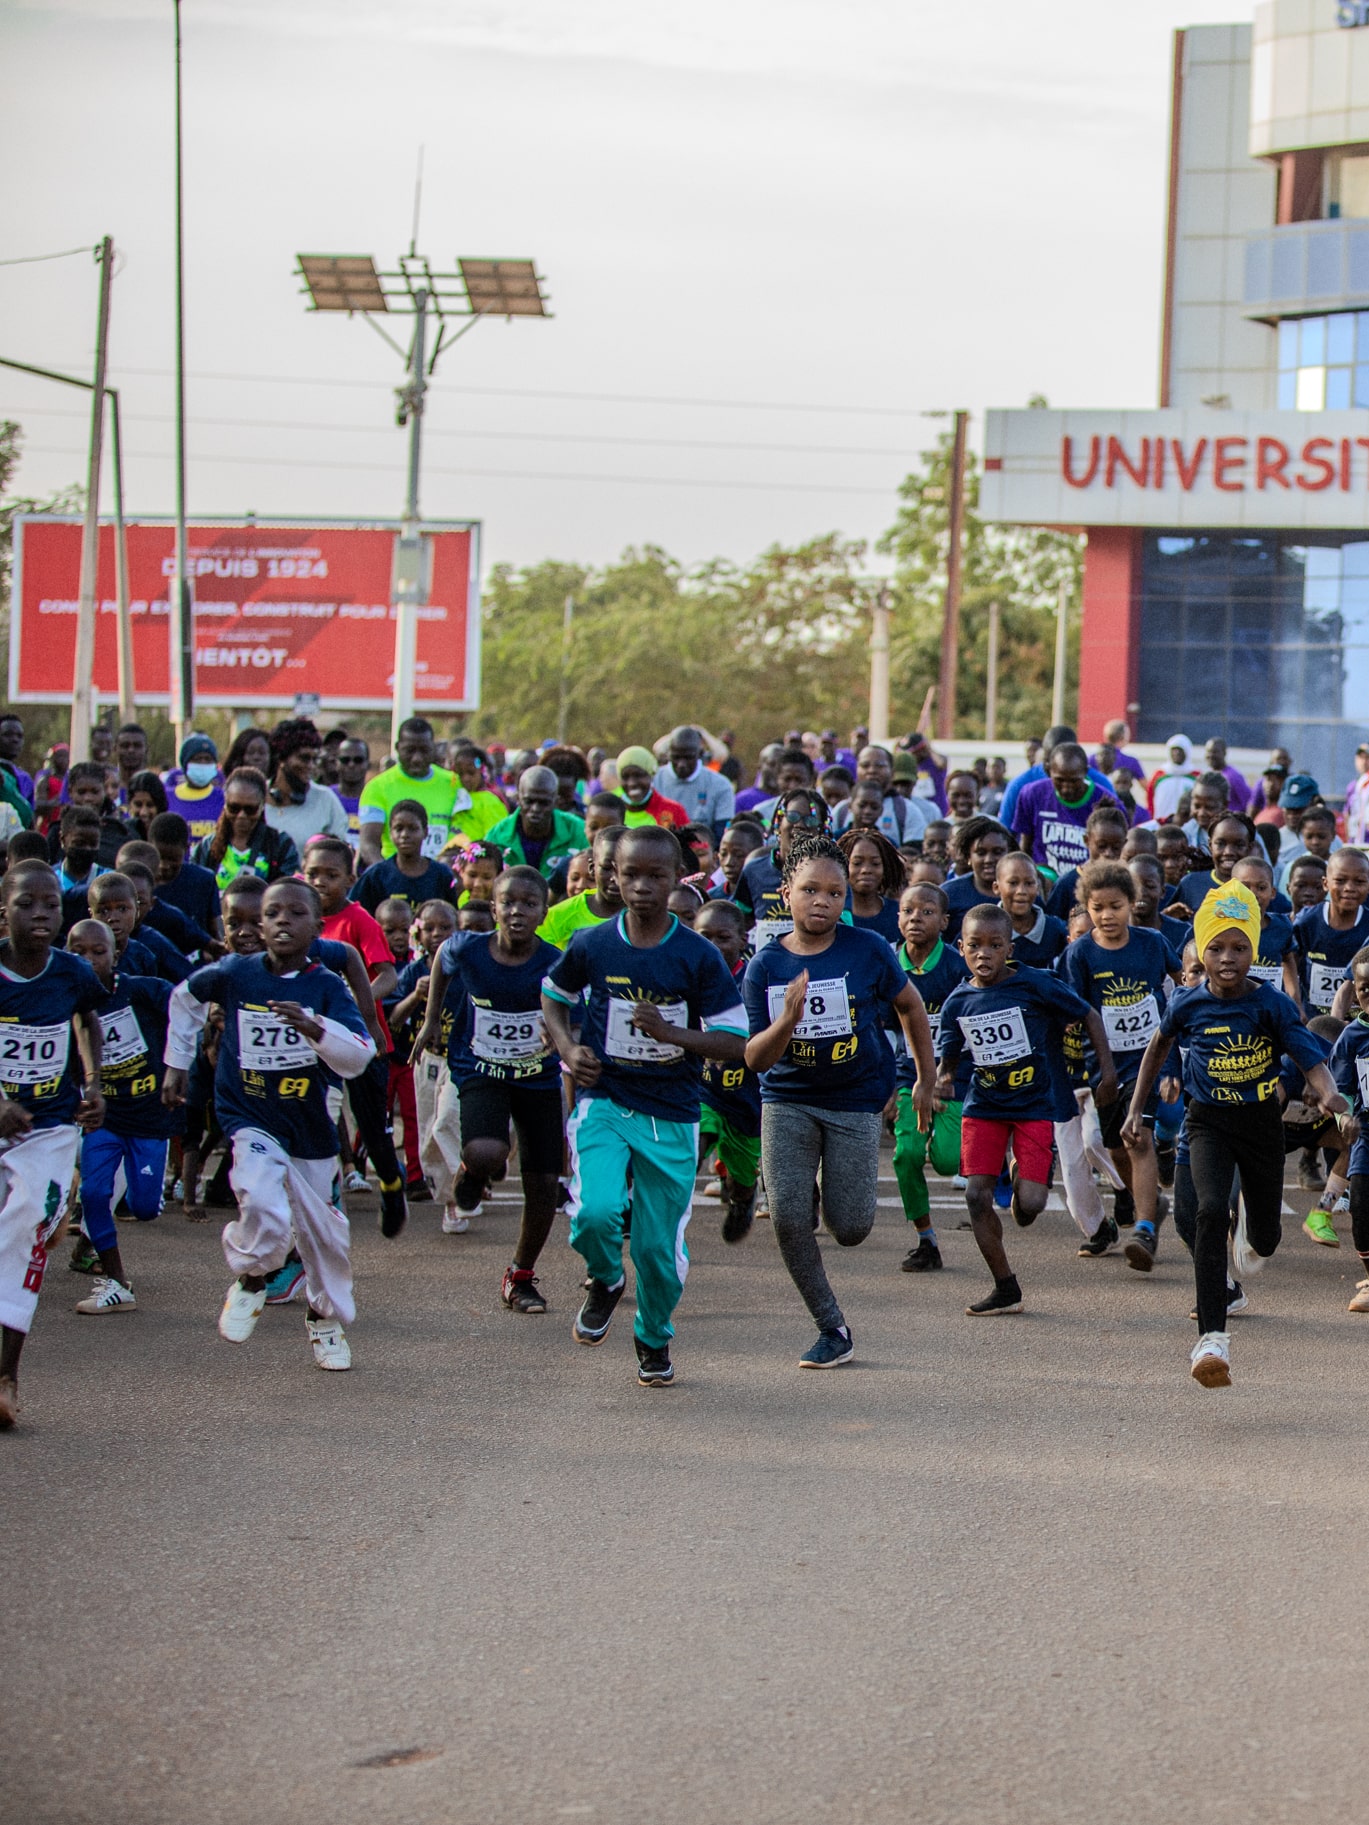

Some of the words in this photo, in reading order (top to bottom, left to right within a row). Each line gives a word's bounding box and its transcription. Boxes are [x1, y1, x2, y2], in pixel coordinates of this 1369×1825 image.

[162, 557, 258, 578] DEPUIS
[266, 559, 328, 578] 1924
[487, 1023, 534, 1041] 429
[1115, 1010, 1153, 1033] 422
[251, 1027, 300, 1047] 278
[971, 1023, 1013, 1046] 330
[3, 1039, 55, 1061] 210
